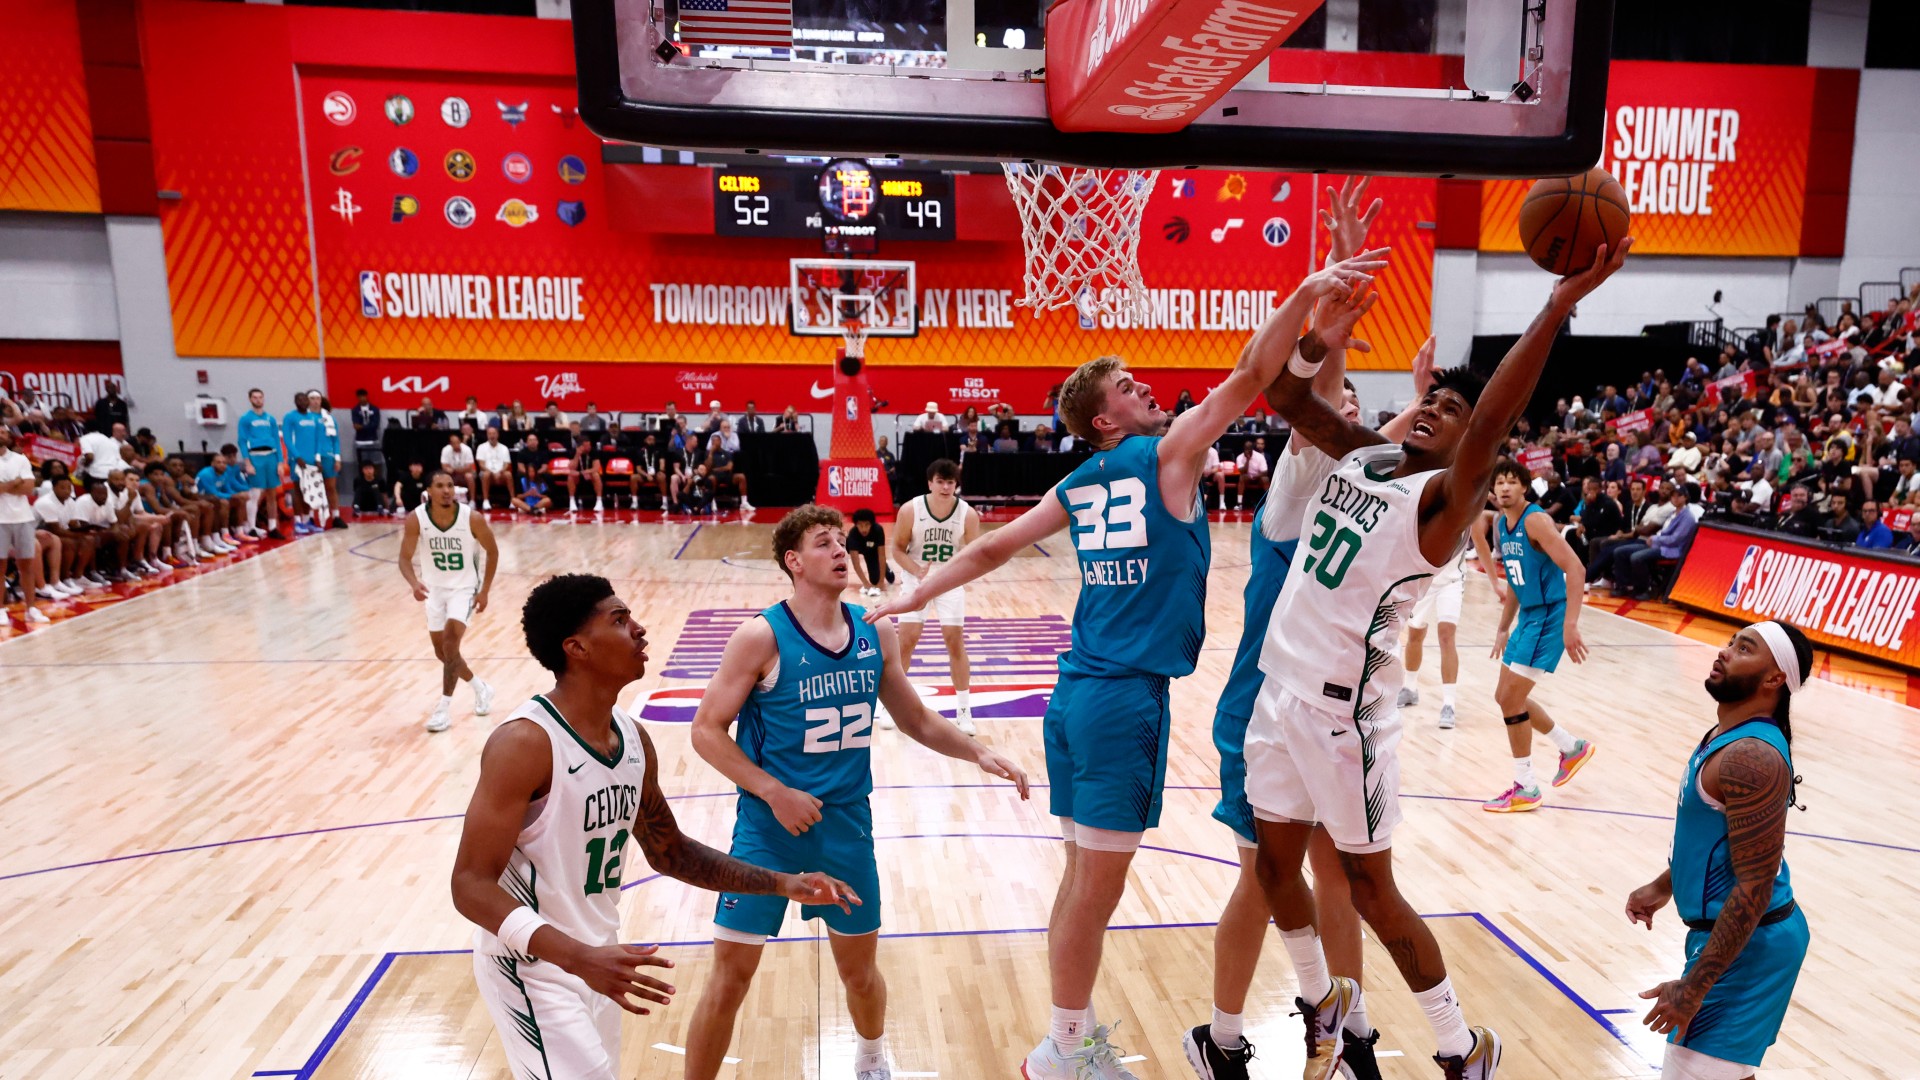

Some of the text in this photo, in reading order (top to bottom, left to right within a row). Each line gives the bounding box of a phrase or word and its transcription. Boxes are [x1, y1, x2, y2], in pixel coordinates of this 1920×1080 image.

[1613, 106, 1740, 162] SUMMER
[719, 176, 760, 192] CELTICS
[734, 195, 769, 225] 52
[907, 201, 941, 228] 49
[838, 226, 876, 235] TISSOT
[384, 272, 585, 321] SUMMER LEAGUE
[957, 288, 1014, 328] HERE
[682, 382, 714, 390] ULTRA
[949, 387, 1000, 398] TISSOT
[843, 466, 879, 482] SUMMER
[843, 480, 873, 497] LEAGUE
[1065, 476, 1148, 550] 33
[1320, 473, 1389, 534] CELTICS
[429, 537, 462, 551] CELTICS
[924, 527, 953, 543] CELTICS
[1303, 510, 1362, 590] 20
[431, 552, 465, 571] 29
[921, 544, 954, 563] 28
[1742, 548, 1920, 651] SUMMER LEAGUE
[798, 669, 875, 703] HORNETS
[803, 701, 872, 753] 22
[583, 784, 637, 832] CELTICS
[583, 828, 629, 898] 12
